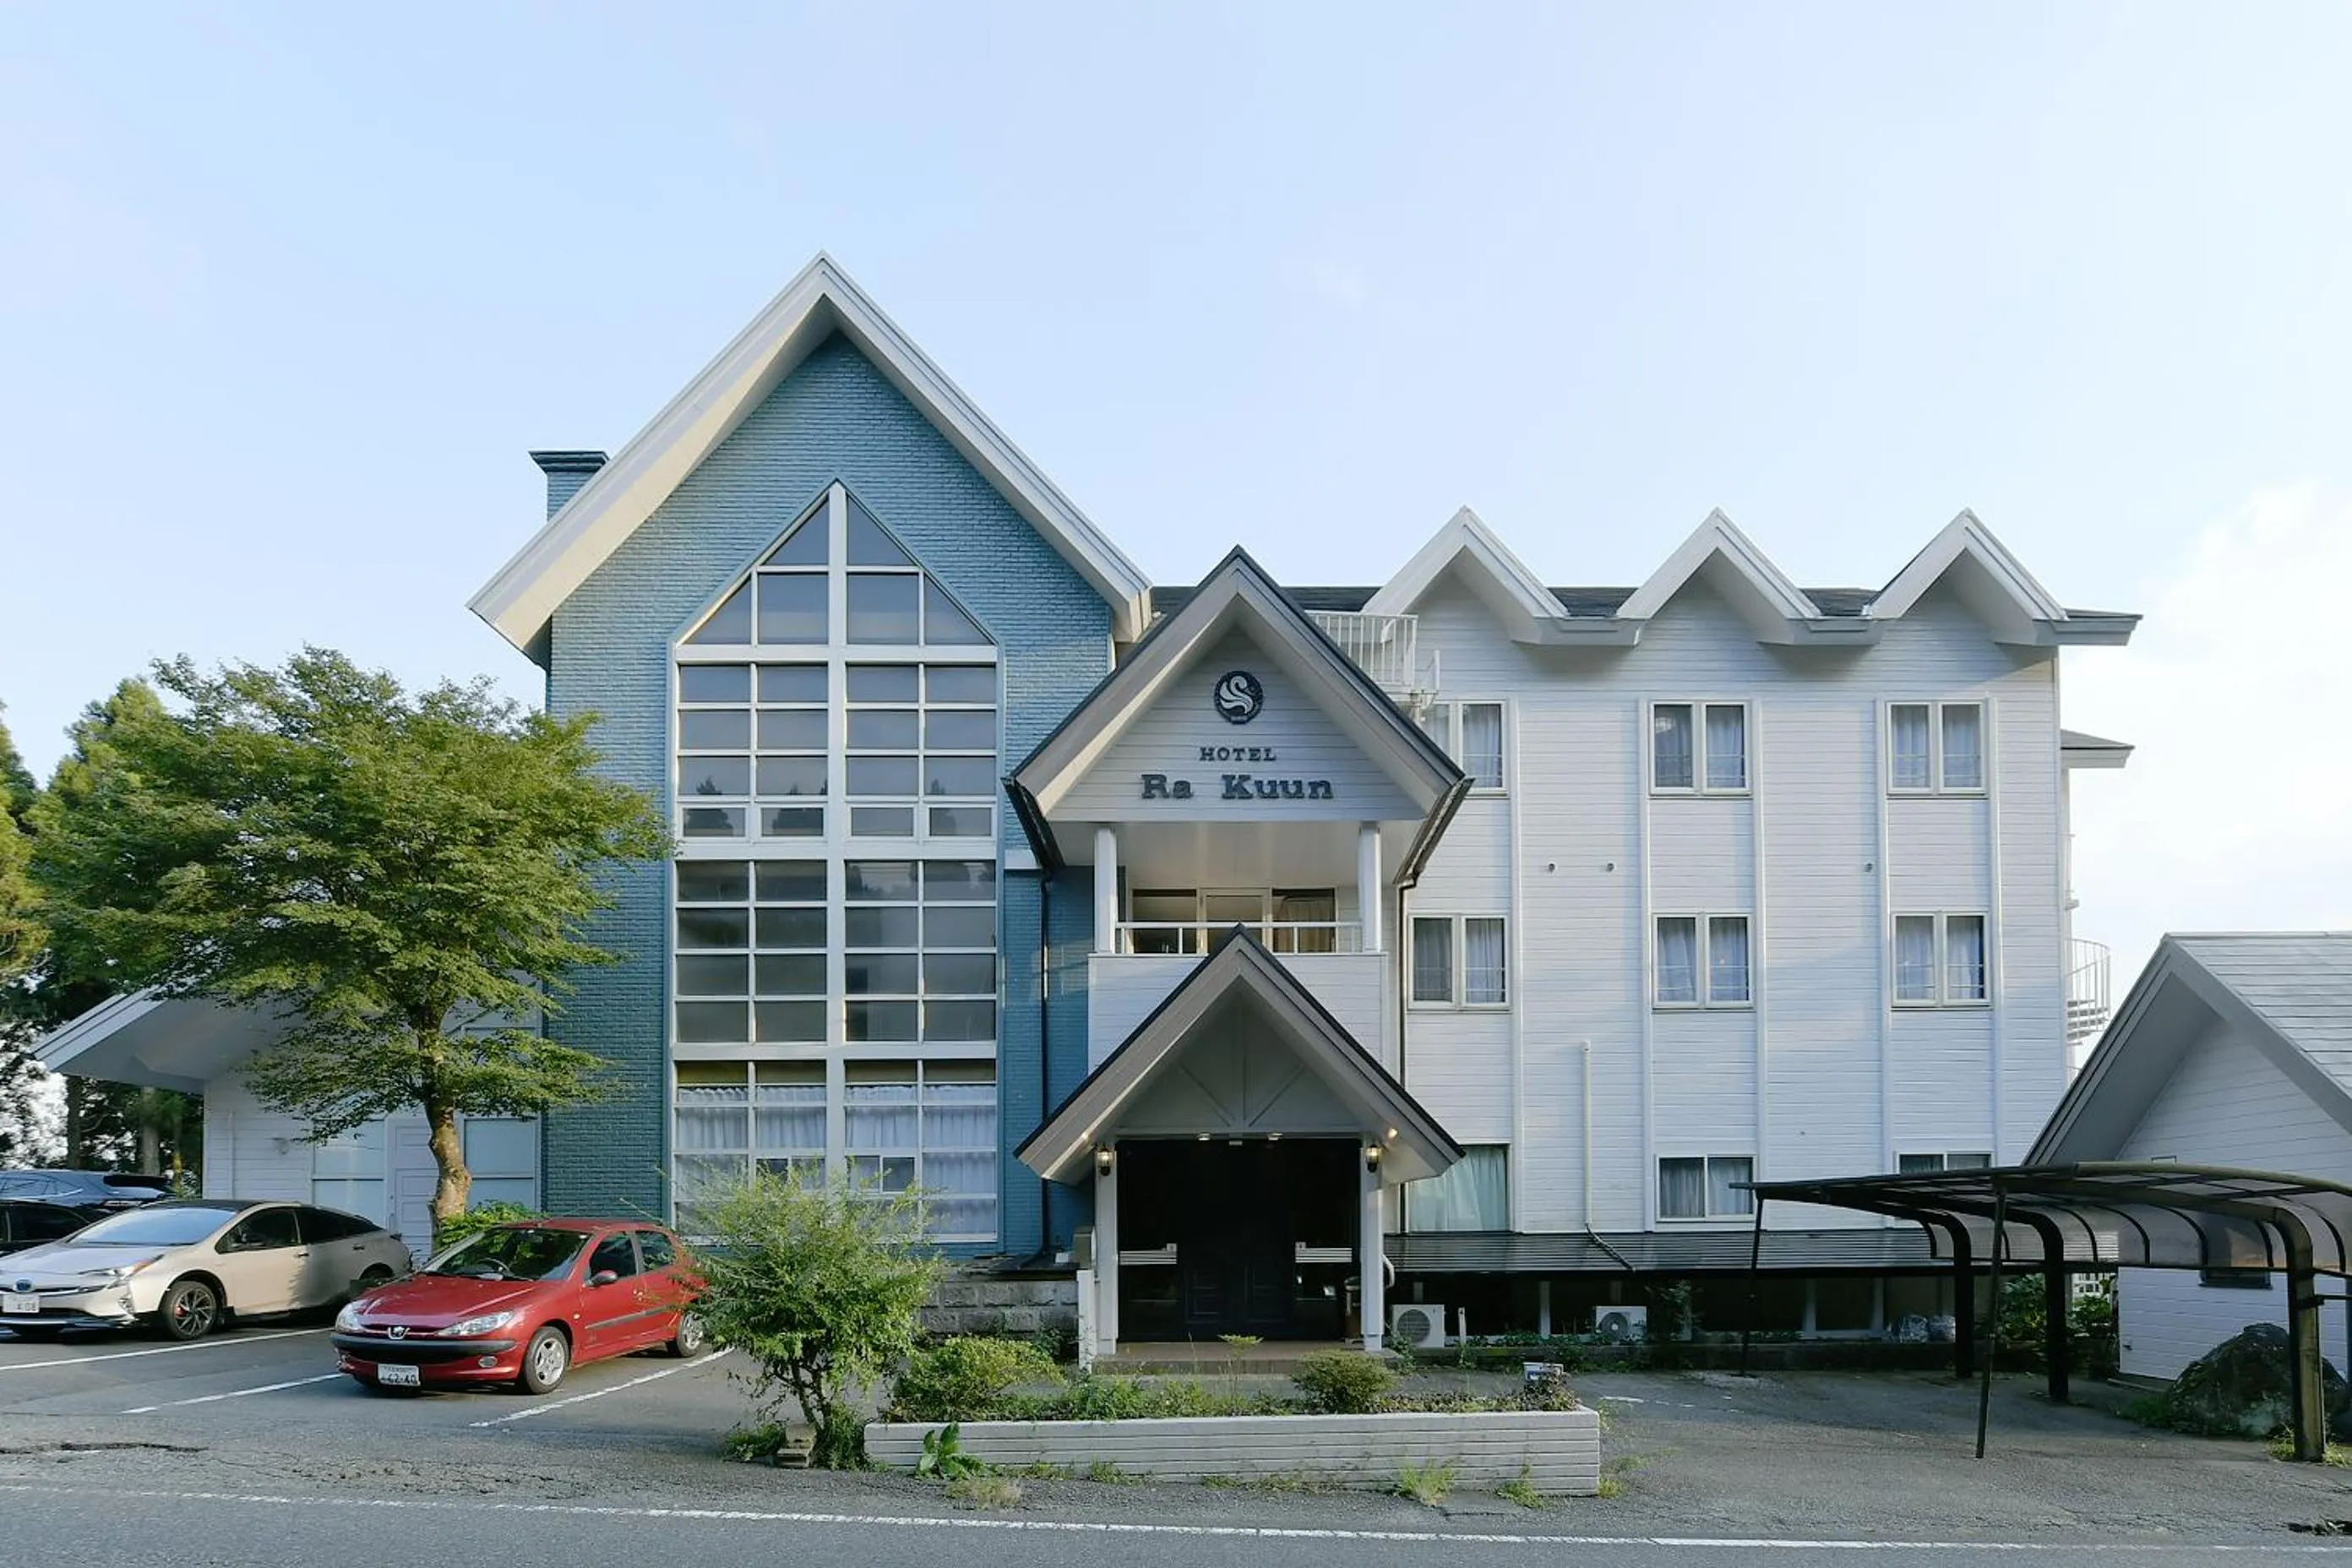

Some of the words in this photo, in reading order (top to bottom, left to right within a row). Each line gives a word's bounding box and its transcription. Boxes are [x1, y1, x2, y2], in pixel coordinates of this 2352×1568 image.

[1200, 747, 1277, 761] HOTEL
[1141, 774, 1194, 799] Ra
[1222, 774, 1334, 799] Kuun
